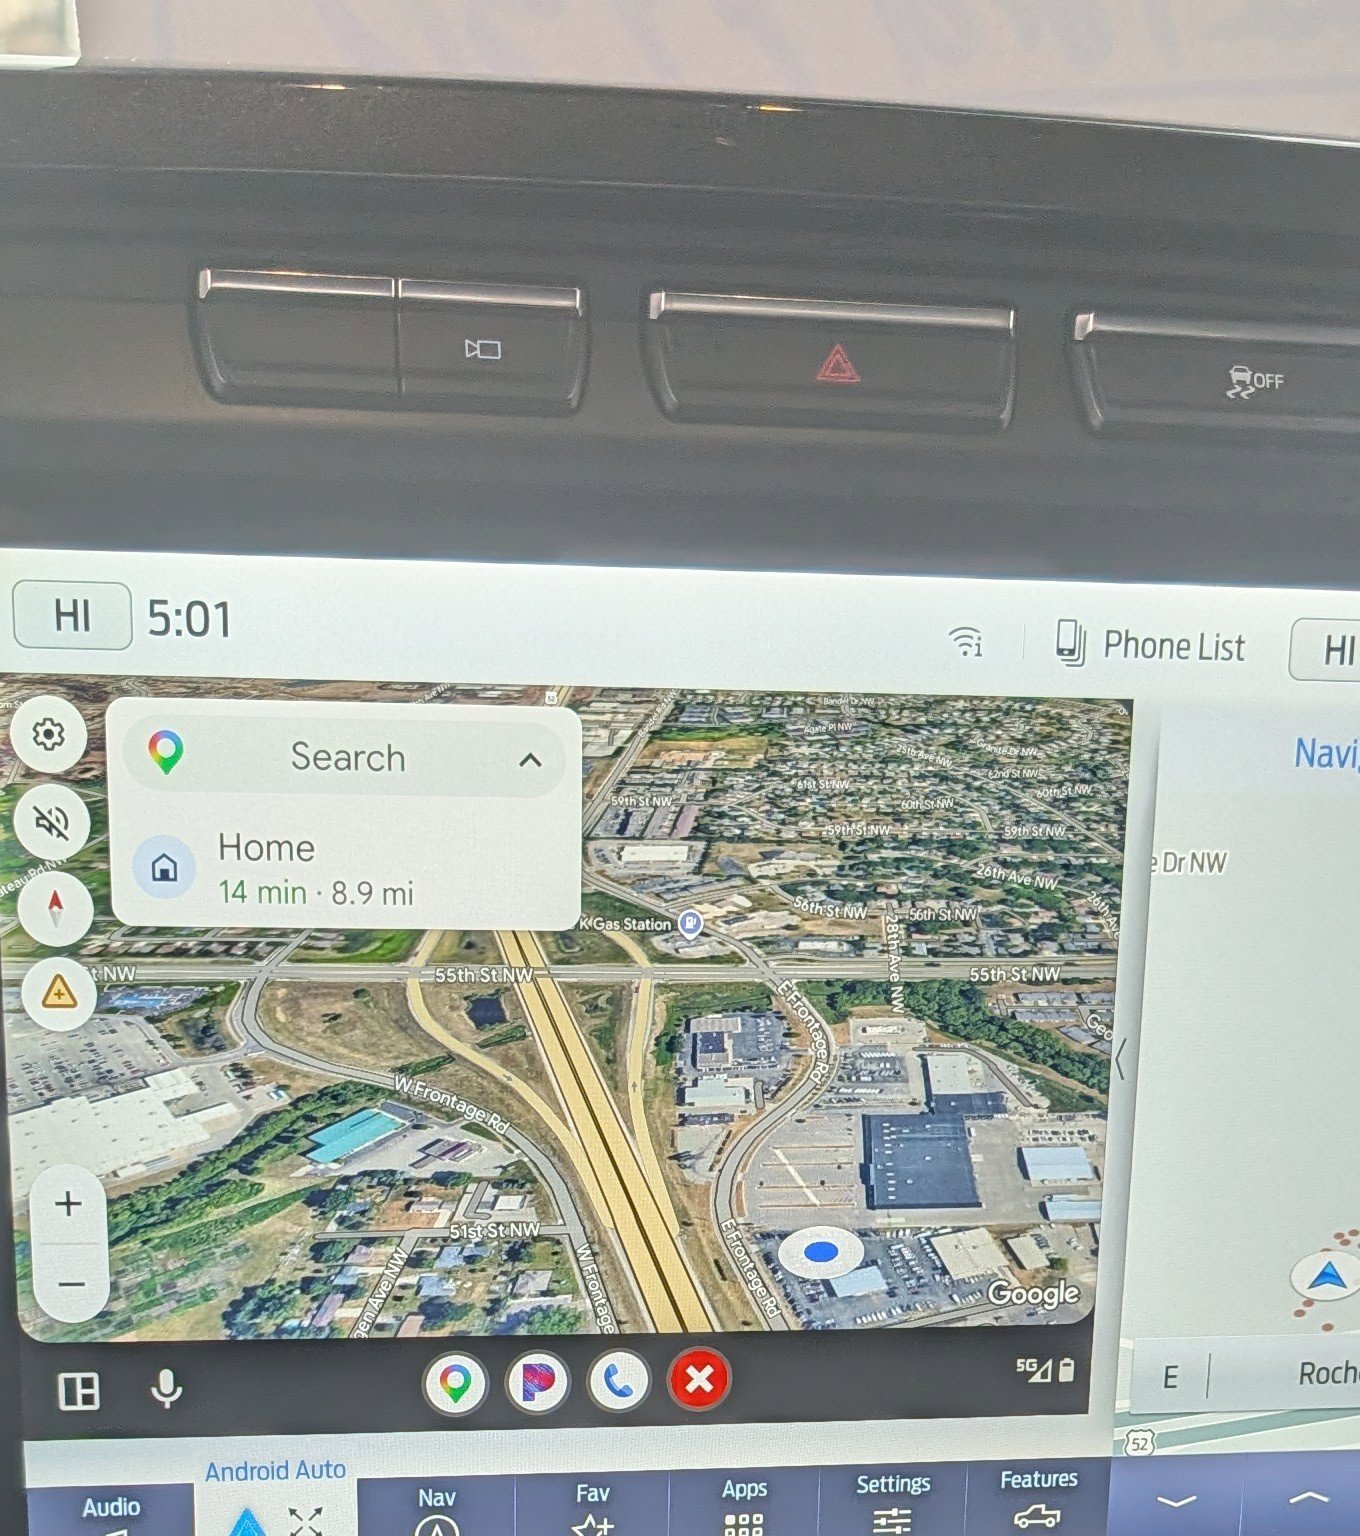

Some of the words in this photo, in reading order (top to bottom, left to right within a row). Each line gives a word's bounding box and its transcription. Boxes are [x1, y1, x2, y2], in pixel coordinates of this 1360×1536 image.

[1253, 372, 1284, 389] OFF
[55, 598, 91, 632] HI
[148, 600, 231, 638] 5:01
[1104, 630, 1191, 661] Phone
[1198, 632, 1246, 663] List
[1324, 635, 1356, 666] HI
[292, 740, 406, 773] Search
[611, 796, 638, 807] 59th
[639, 796, 652, 807] St
[652, 796, 673, 807] NW
[826, 824, 853, 836] 59th
[853, 825, 866, 836] St
[867, 825, 891, 836] NW
[1004, 825, 1029, 837] 59th
[1031, 826, 1044, 837] St
[1045, 826, 1066, 837] NW
[219, 832, 315, 863] Home
[1163, 851, 1186, 873] Dr
[1189, 852, 1228, 873] NW
[976, 864, 1006, 880] 26th
[1007, 870, 1032, 887] Ave
[1033, 875, 1059, 891] NW
[220, 880, 247, 905] 14
[258, 880, 307, 906] min
[331, 881, 374, 907] 8.9
[383, 881, 414, 907] mi
[1087, 890, 1111, 919] 26th
[793, 895, 825, 916] 56th
[825, 905, 841, 919] St
[843, 906, 868, 920] NW
[909, 908, 938, 922] 56th
[939, 908, 954, 922] St
[955, 908, 978, 922] NW
[594, 917, 621, 931] Gas
[623, 917, 672, 931] Station
[885, 914, 899, 952] 28th
[103, 965, 137, 982] NW
[435, 966, 476, 983] 55th
[480, 967, 502, 983] St
[505, 967, 534, 984] NW
[888, 954, 902, 983] Ave
[969, 967, 1007, 982] 55th
[1010, 967, 1028, 982] St
[1031, 966, 1061, 982] NW
[777, 979, 796, 997] E
[891, 985, 905, 1014] NW
[785, 990, 829, 1060] Frontage
[810, 1061, 830, 1085] Rd
[394, 1074, 413, 1093] W
[413, 1080, 487, 1120] Frontage
[487, 1112, 511, 1135] Rd
[449, 1223, 483, 1239] 51st
[488, 1223, 505, 1238] St
[510, 1222, 541, 1238] NW
[721, 1218, 737, 1232] E
[575, 1242, 591, 1263] W
[726, 1230, 768, 1298] Frontage
[367, 1278, 393, 1312] Ave
[383, 1246, 410, 1279] NW
[581, 1264, 616, 1335] Frontage
[988, 1279, 1080, 1309] Google
[761, 1296, 782, 1319] Rd
[1016, 1358, 1038, 1373] 5G
[1164, 1365, 1179, 1389] E
[1131, 1437, 1149, 1452] 52
[204, 1460, 290, 1483] Android
[295, 1460, 347, 1480] Auto
[1001, 1470, 1079, 1490] Features
[418, 1488, 457, 1507] Nav
[576, 1483, 610, 1503] Fav
[722, 1480, 768, 1501] Apps
[857, 1474, 932, 1498] Settings
[81, 1497, 141, 1518] Audio
